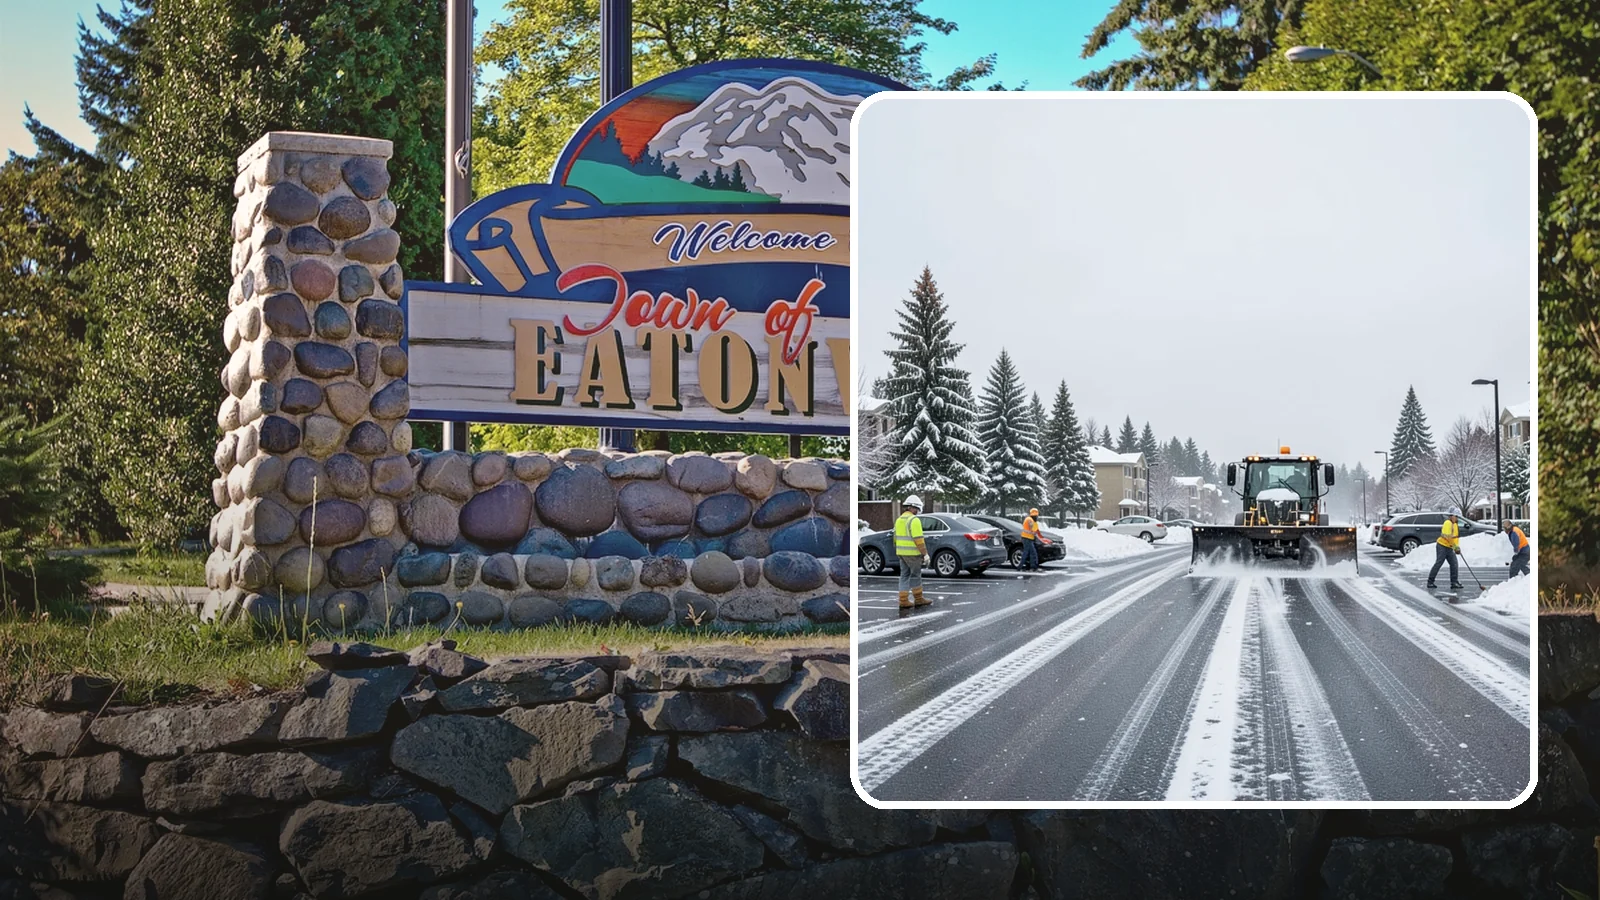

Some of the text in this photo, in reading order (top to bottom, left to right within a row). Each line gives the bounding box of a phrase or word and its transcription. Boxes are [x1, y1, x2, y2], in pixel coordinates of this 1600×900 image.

[653, 220, 837, 263] Welcome
[556, 263, 826, 365] Town of
